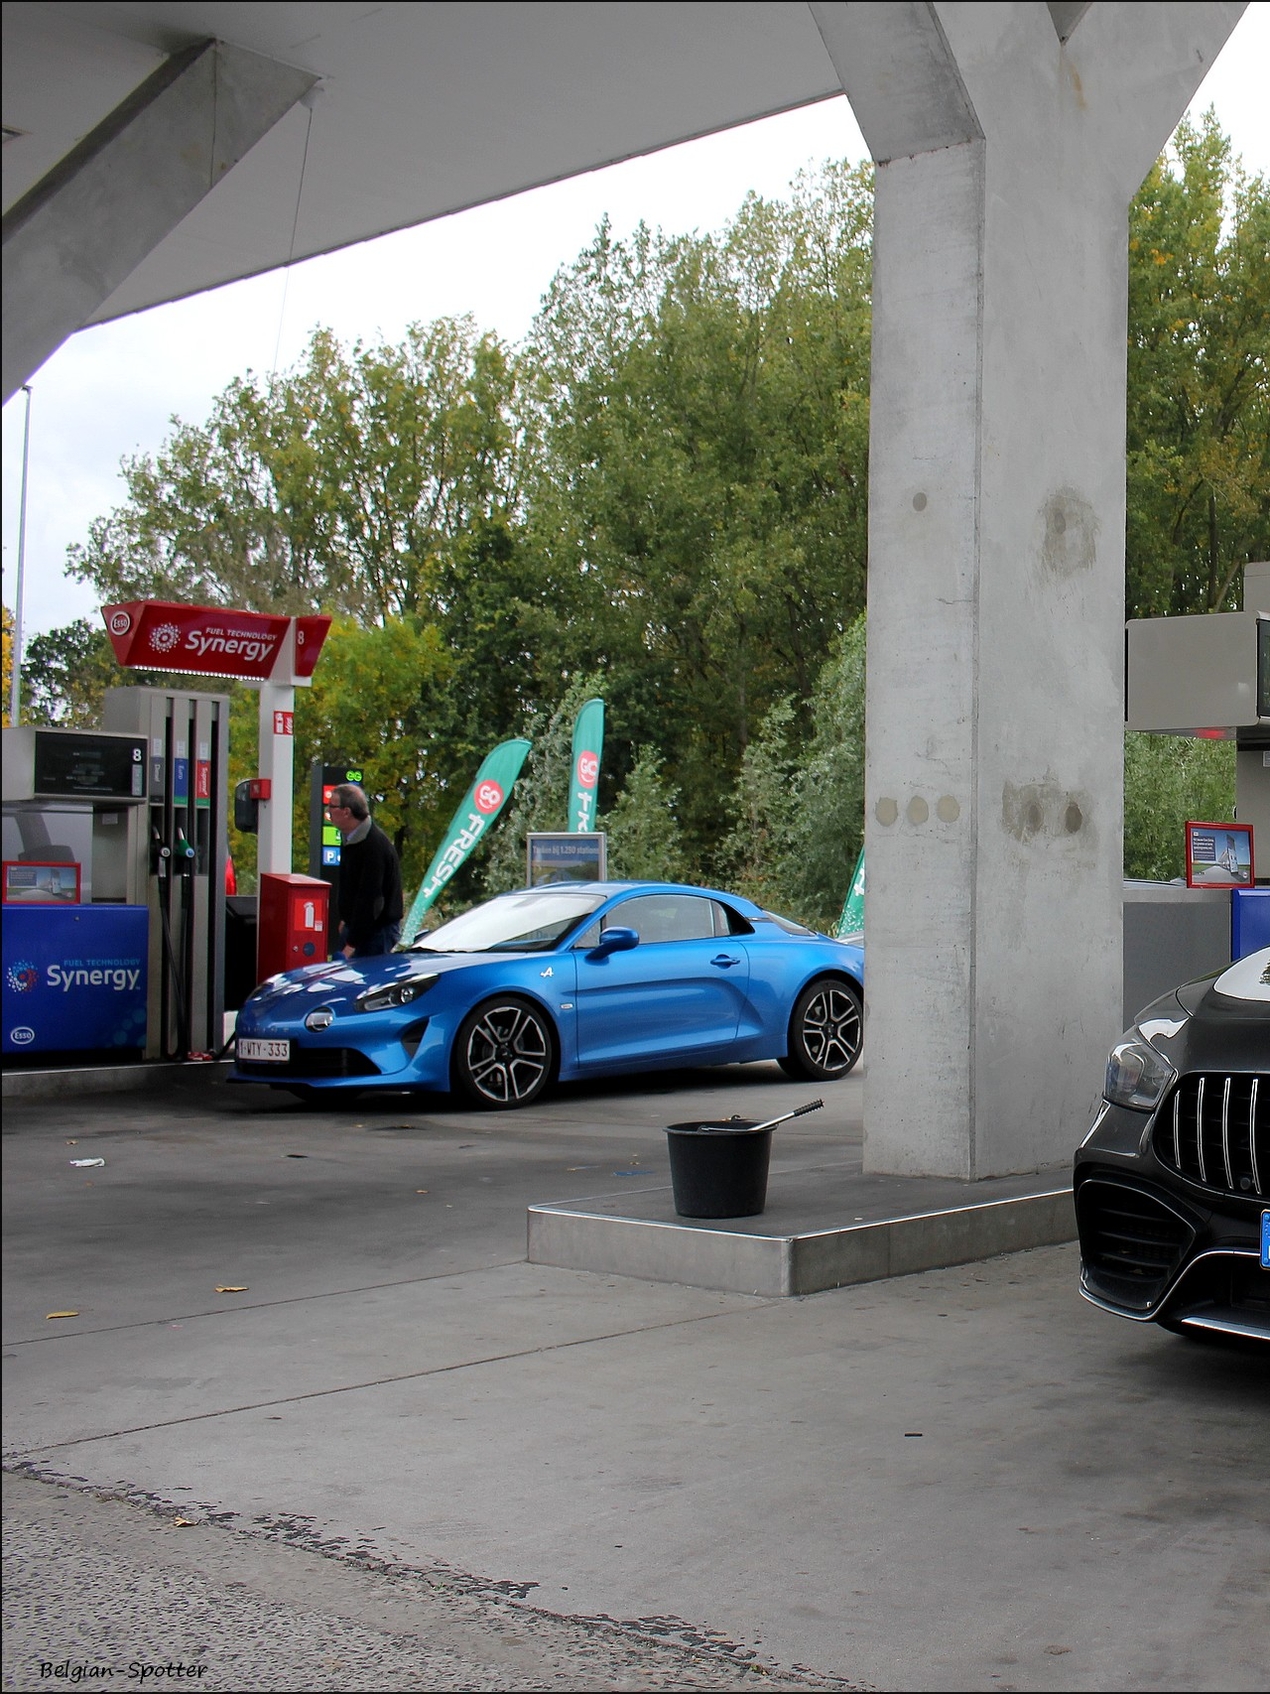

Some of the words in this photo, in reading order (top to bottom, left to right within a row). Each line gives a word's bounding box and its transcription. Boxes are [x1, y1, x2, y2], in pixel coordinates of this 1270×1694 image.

[113, 619, 128, 629] Esso
[206, 626, 224, 636] FUEL
[228, 629, 278, 642] TECHNOLOGY
[297, 630, 305, 646] 8
[185, 630, 274, 662] Synergy
[133, 748, 142, 762] 8
[64, 959, 84, 967] FUEL
[86, 959, 140, 967] TECHNOLOGY
[47, 964, 140, 992] Synergy
[14, 1032, 32, 1040] Esso
